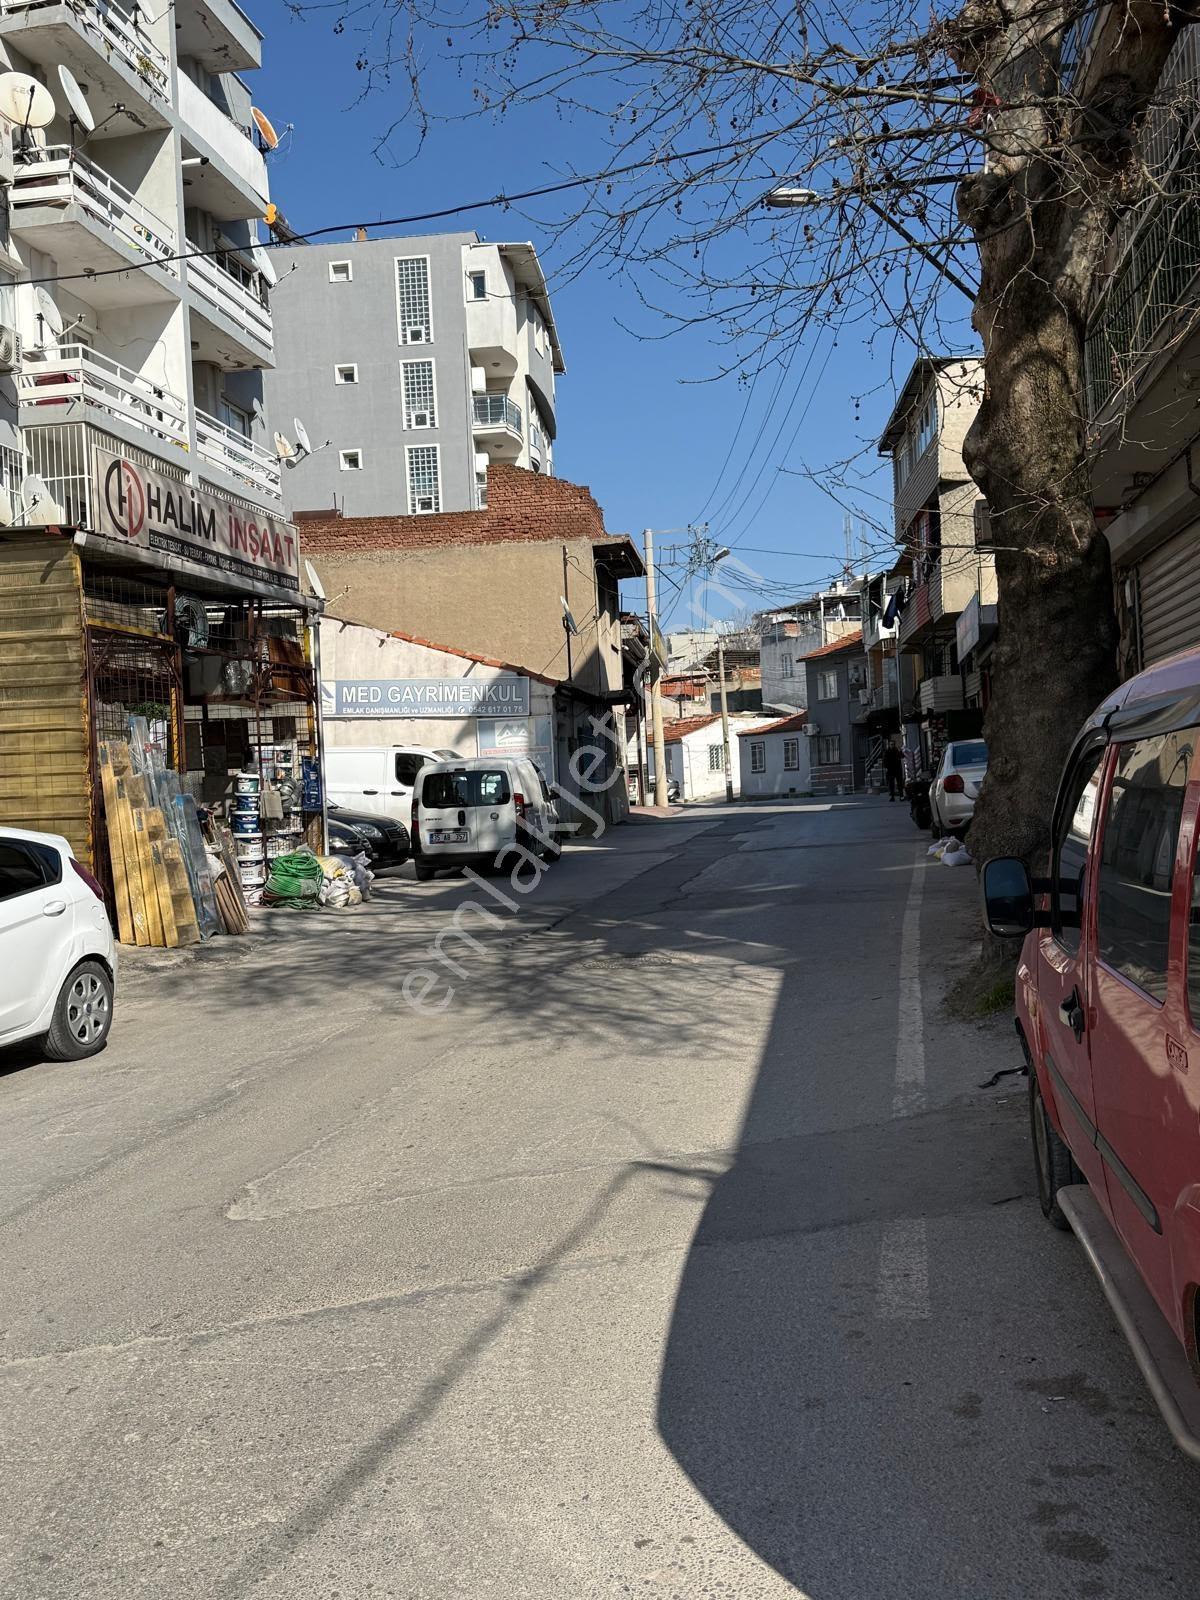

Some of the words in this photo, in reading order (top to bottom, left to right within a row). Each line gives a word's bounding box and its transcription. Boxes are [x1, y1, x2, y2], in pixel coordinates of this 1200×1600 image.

[147, 482, 217, 542] HALİM
[228, 504, 294, 567] İNŞAAT
[342, 686, 382, 703] MED
[387, 682, 523, 703] GAYRİMENKUL
[419, 706, 454, 714] UZMANLIĞI
[468, 705, 486, 713] 0542
[487, 705, 500, 713] 617
